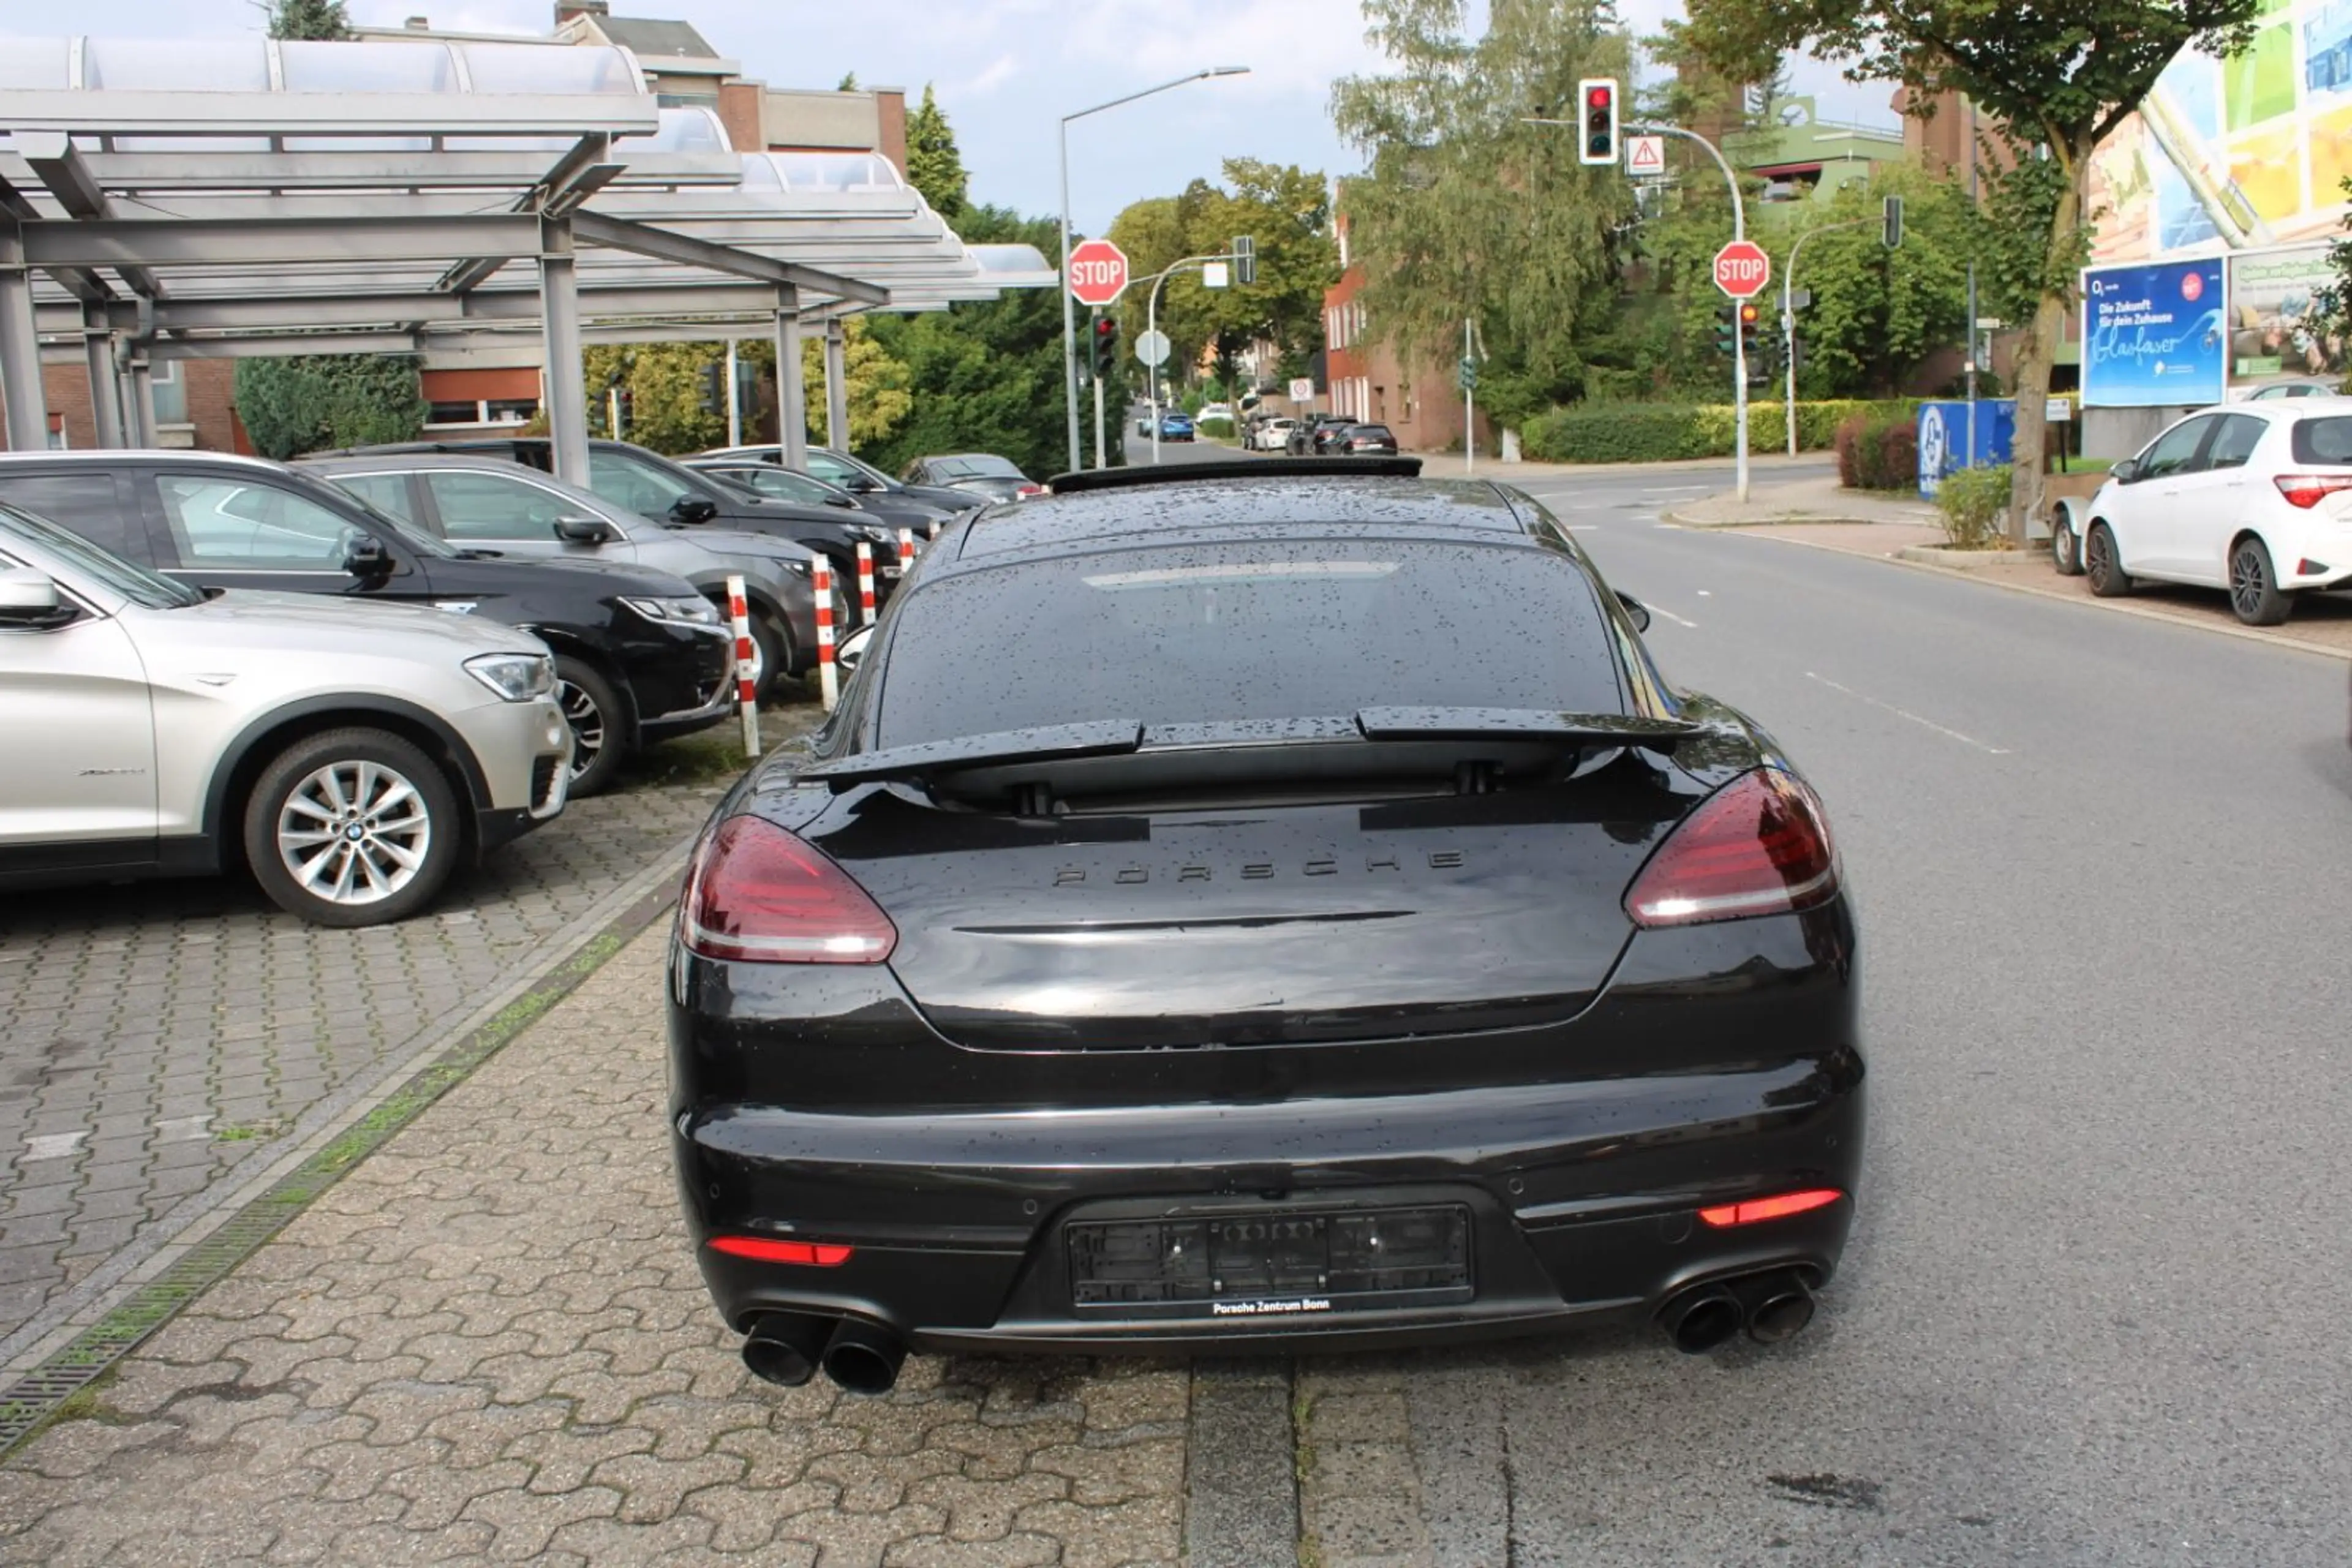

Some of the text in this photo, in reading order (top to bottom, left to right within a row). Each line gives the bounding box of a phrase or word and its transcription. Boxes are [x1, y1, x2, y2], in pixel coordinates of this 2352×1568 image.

[1071, 260, 1121, 285] STOP
[1719, 258, 1763, 281] STOP
[2099, 299, 2151, 314] Die Zukunft
[2099, 314, 2173, 327] für dein Zuhause
[1052, 851, 1464, 887] PORSCHE
[1213, 1298, 1330, 1314] Porsche Zentrum Bonn
